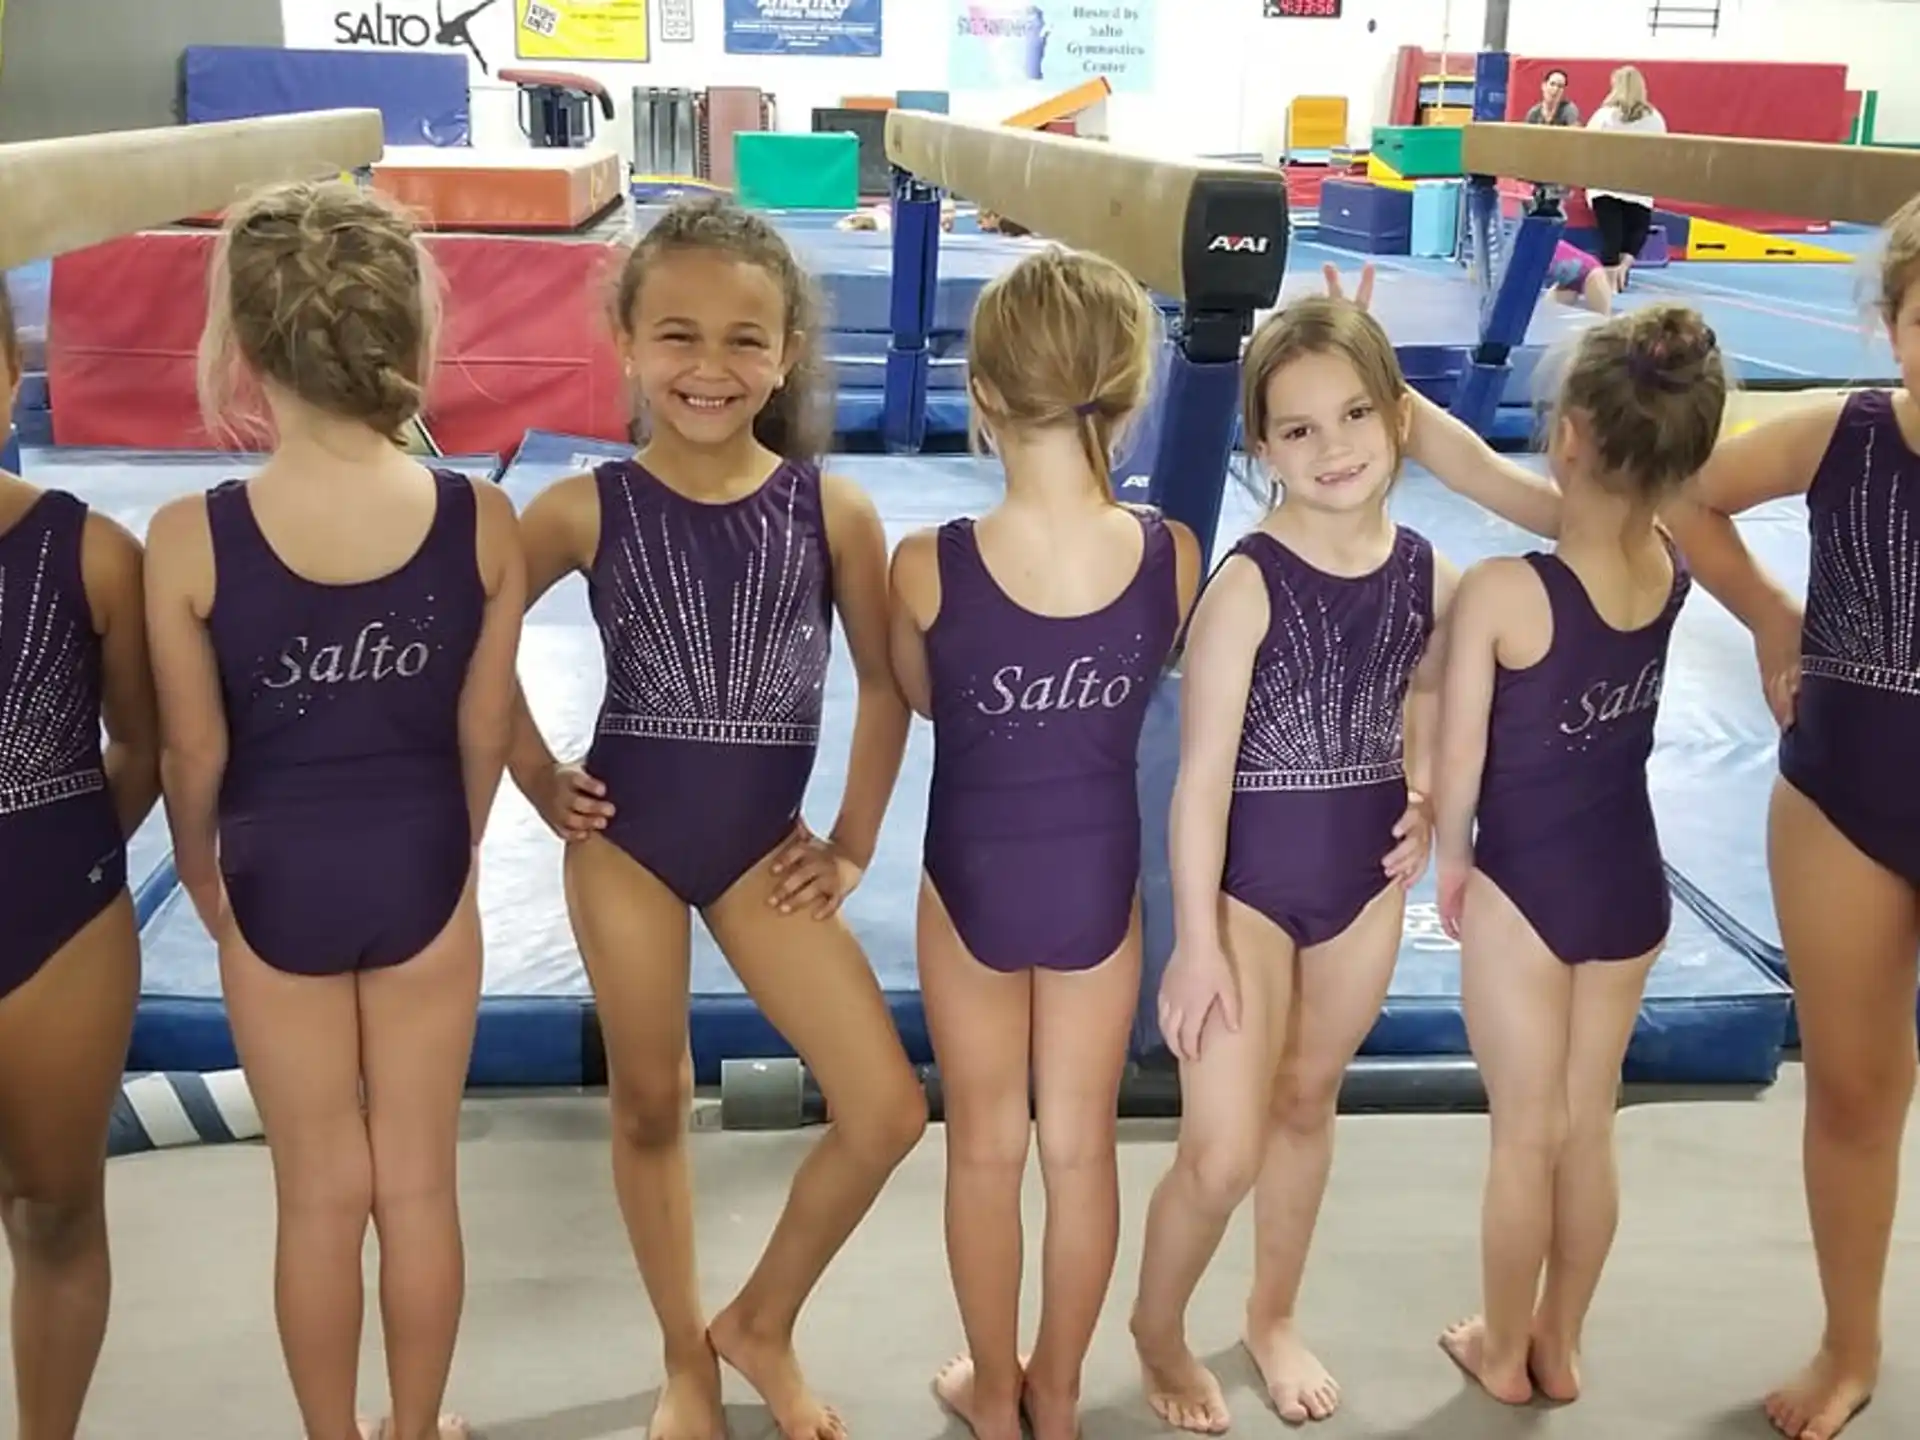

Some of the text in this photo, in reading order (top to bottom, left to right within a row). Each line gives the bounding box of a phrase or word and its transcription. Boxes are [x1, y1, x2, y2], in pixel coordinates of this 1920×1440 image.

[335, 2, 430, 47] SALTO
[262, 621, 430, 688] Salto
[977, 656, 1131, 715] Salto
